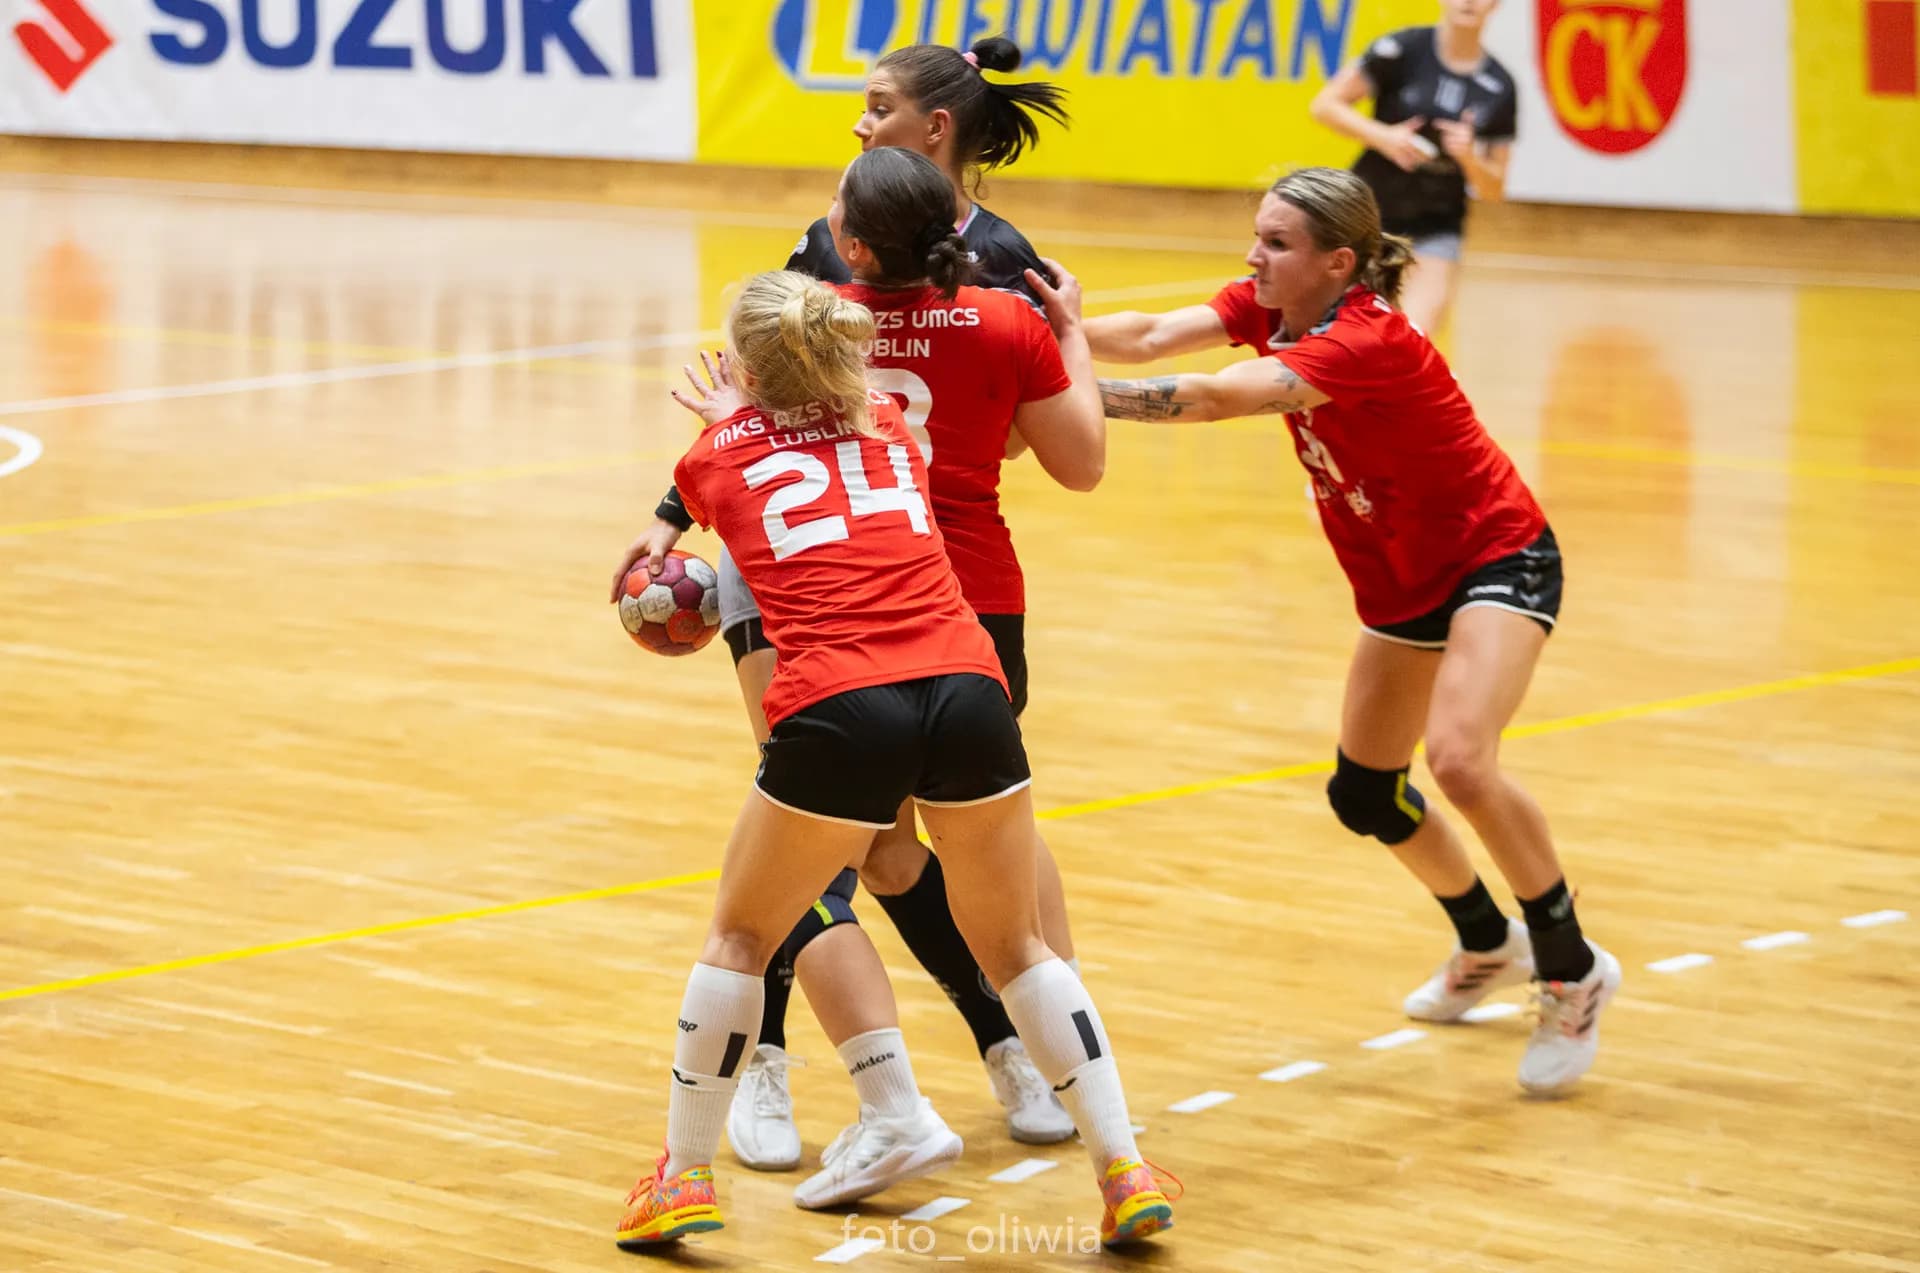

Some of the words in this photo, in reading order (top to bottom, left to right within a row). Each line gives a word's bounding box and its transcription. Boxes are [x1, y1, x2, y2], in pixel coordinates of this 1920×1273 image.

[148, 0, 658, 78] SUZUKI
[1546, 10, 1664, 132] CK
[859, 338, 931, 358] UBLIN
[874, 311, 905, 329] ZS
[912, 307, 980, 328] UMCS
[713, 415, 767, 450] MKS
[774, 402, 824, 430] AZS
[832, 387, 890, 414] UCS
[741, 440, 931, 562] 24
[848, 1051, 896, 1077] adidas
